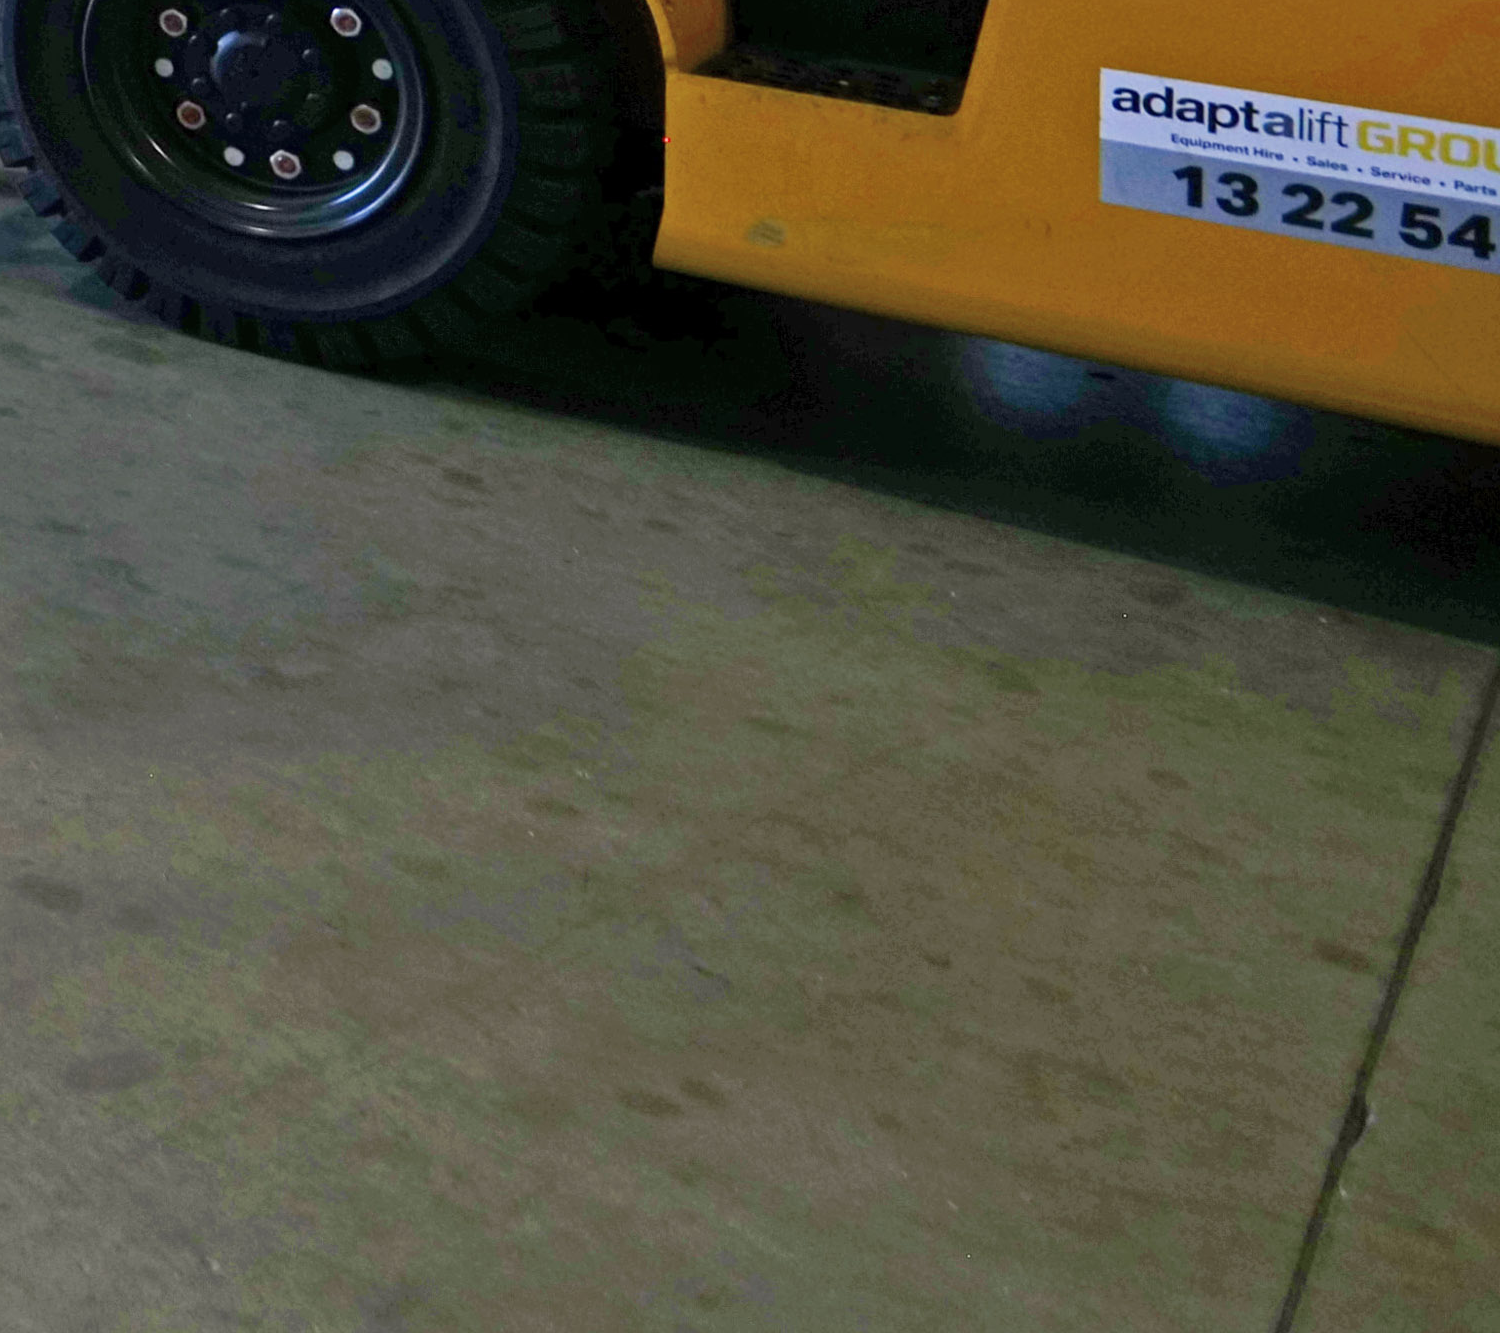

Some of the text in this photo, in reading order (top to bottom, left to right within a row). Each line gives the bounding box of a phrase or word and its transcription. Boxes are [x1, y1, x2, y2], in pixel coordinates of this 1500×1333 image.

[1170, 132, 1498, 197] Equipment Hire Sales Service Parts
[1172, 164, 1497, 261] 13 22 54
